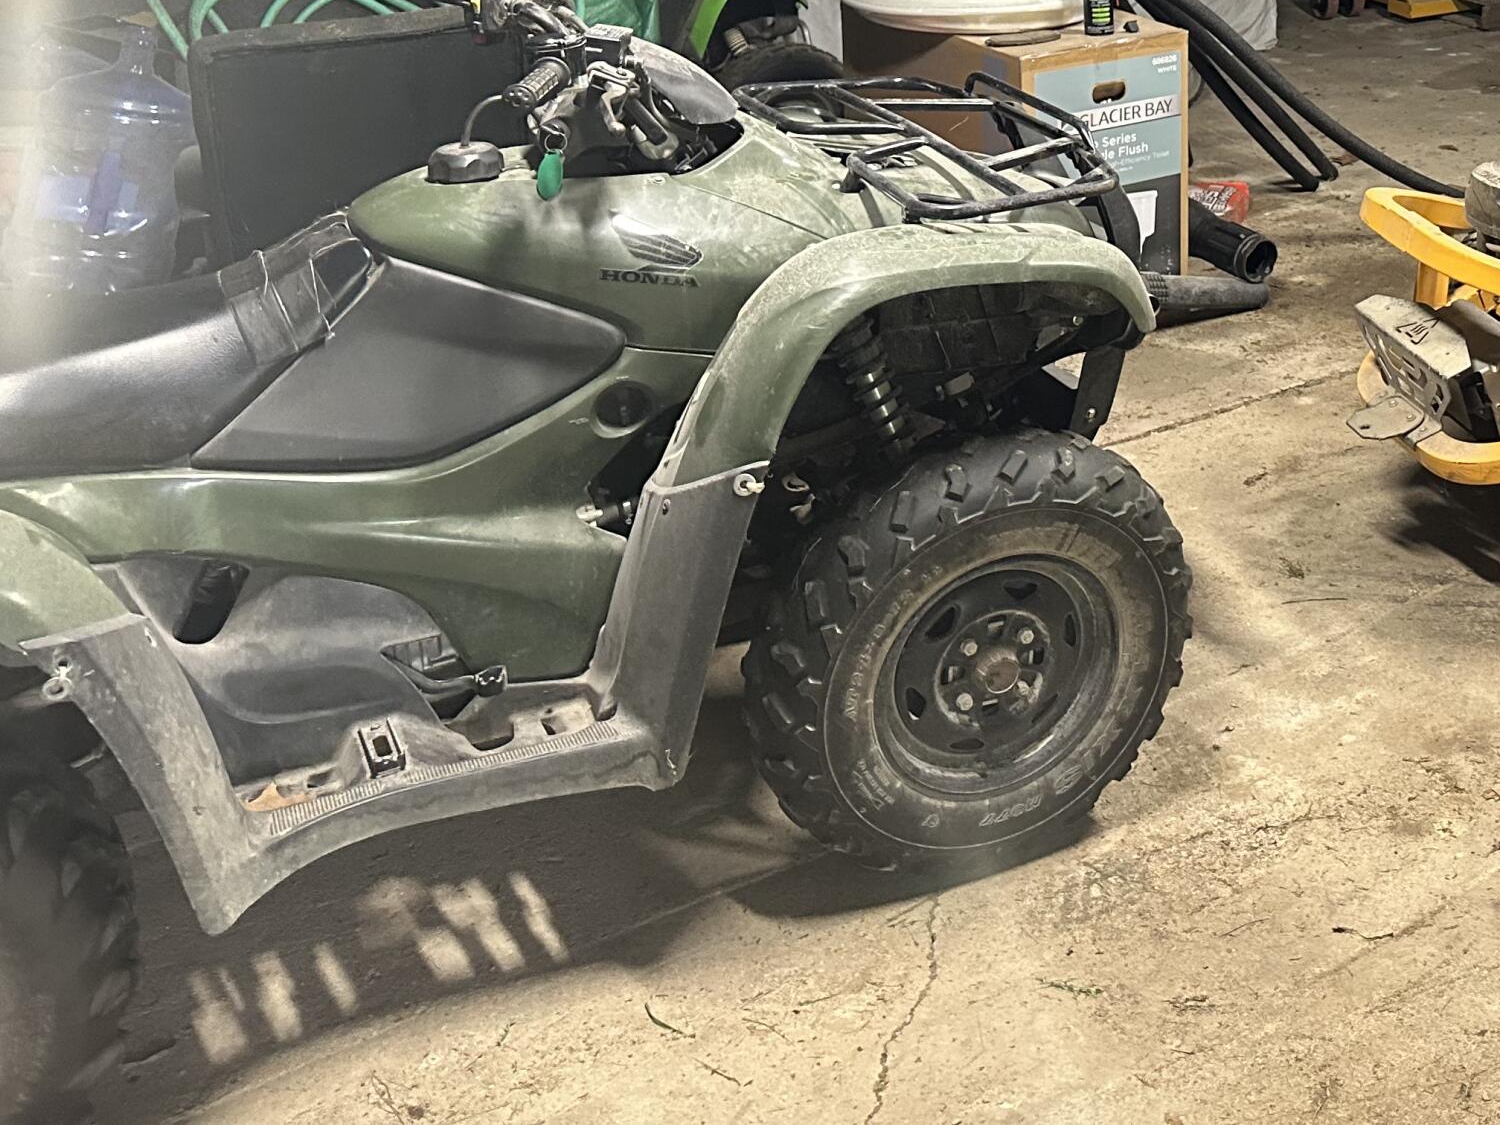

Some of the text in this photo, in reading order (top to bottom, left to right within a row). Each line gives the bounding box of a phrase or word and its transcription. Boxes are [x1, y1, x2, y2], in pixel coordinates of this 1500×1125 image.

[1144, 97, 1173, 118] BAY
[1101, 132, 1137, 148] Series
[1118, 141, 1149, 156] Flush
[600, 269, 700, 288] HONDA
